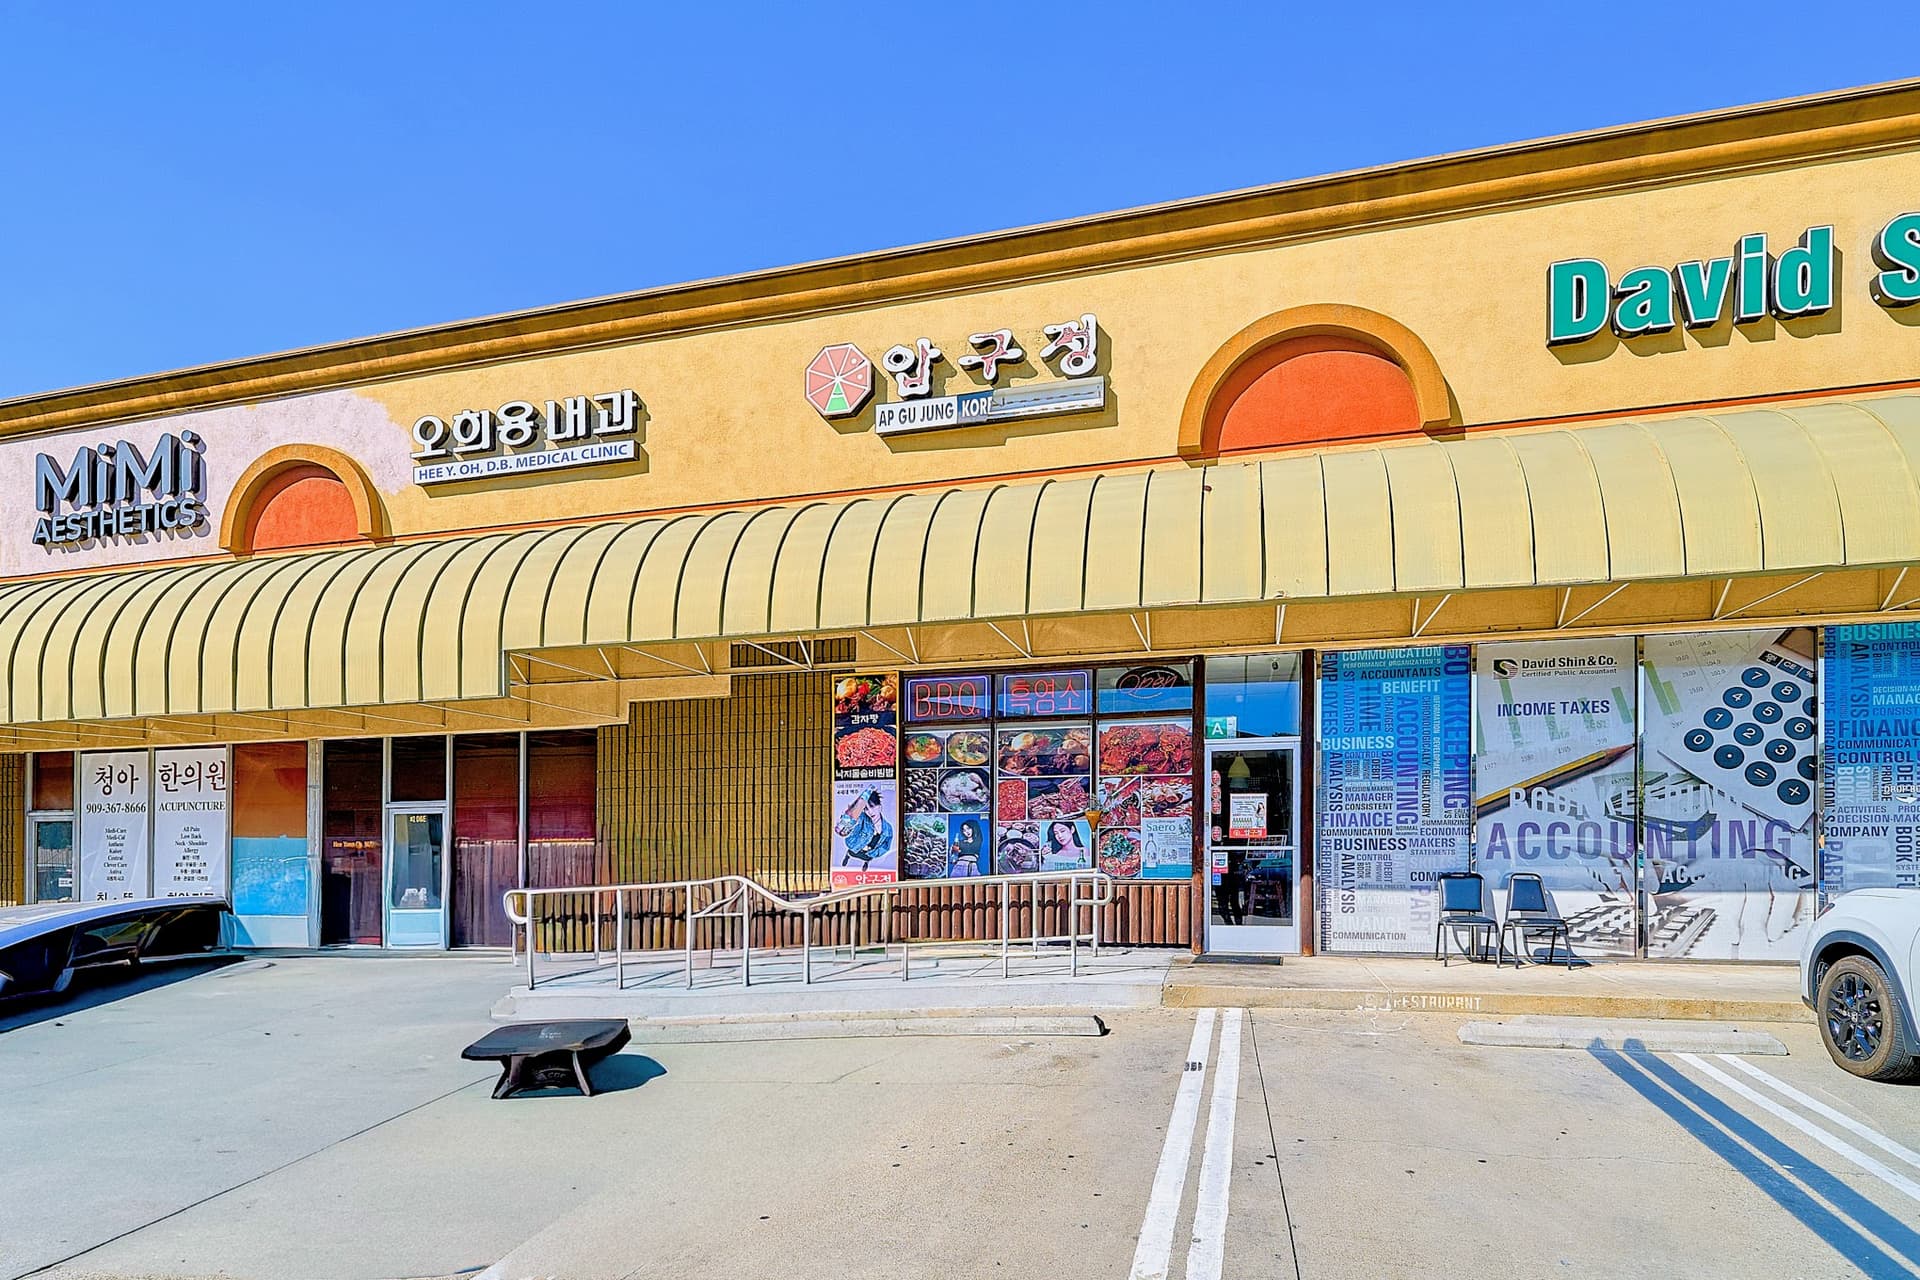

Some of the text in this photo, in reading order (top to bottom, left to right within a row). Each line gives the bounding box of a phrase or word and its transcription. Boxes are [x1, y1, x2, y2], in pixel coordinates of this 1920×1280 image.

[1547, 224, 1835, 344] David
[882, 313, 1098, 398] 압구정
[879, 408, 894, 427] AP
[899, 405, 916, 423] GU
[920, 400, 954, 422] JUNG
[36, 429, 198, 511] MiMi
[419, 444, 628, 481] HEE Y. OH, D.B. MEDICAL CLINIC
[32, 498, 198, 544] AESTHETICS
[1342, 647, 1440, 661] COMMUNICATION
[1522, 655, 1618, 669] David Shin & Co.
[1360, 667, 1441, 680] ACCOUNTANTS
[1751, 671, 1763, 680] 7
[1850, 643, 1869, 718] ANALYSIS
[1321, 652, 1338, 735] EMPLOYEES
[1382, 679, 1440, 694] BENEFIT
[1781, 686, 1793, 695] 8
[1010, 679, 1081, 714] 흑염소
[1343, 670, 1355, 734] STANDARDS
[1732, 693, 1743, 702] 4
[1360, 681, 1381, 732] TIME
[1497, 700, 1610, 717] INCOME TAXES
[1762, 706, 1775, 716] 5
[1714, 713, 1724, 723] 1
[1211, 722, 1223, 736] A
[1443, 645, 1469, 808] BOOKKEEPING
[1742, 728, 1756, 739] 2
[1794, 723, 1807, 732] 6
[1322, 735, 1395, 751] BUSINESS
[1775, 744, 1788, 755] 3
[1345, 751, 1380, 759] CONTROL
[1396, 695, 1419, 825] ACCOUNTING
[1837, 750, 1915, 765] CONTROL
[1371, 759, 1380, 779] DEBIT
[1382, 751, 1393, 780] BANK
[94, 764, 139, 796] 청아
[158, 760, 226, 792] 한의원
[1329, 752, 1343, 812] ANALYSIS
[1837, 766, 1854, 804] BOOK
[1345, 793, 1393, 802] MANAGER
[1421, 769, 1432, 818] REGULATORY
[86, 803, 147, 813] 909-367-8666
[158, 801, 226, 811] ACUPUNCTURE
[1345, 803, 1393, 811] CONSISTENT
[1837, 806, 1887, 814] ACTIVITIES
[1146, 823, 1176, 831] Saero
[1321, 812, 1393, 828] FINANCE
[1321, 828, 1393, 837] COMMUNICATION
[1823, 825, 1889, 838] COMPANY
[1334, 837, 1407, 851] BUSINESS
[1409, 837, 1456, 848] MAKERS
[1485, 820, 1793, 860] ACCOUNTING
[1896, 826, 1912, 863] BOOK
[1384, 861, 1393, 883] DEBIT
[1824, 841, 1843, 888] PART
[1341, 853, 1355, 914] ANALYSIS
[1332, 931, 1407, 940] COMMUNICATION
